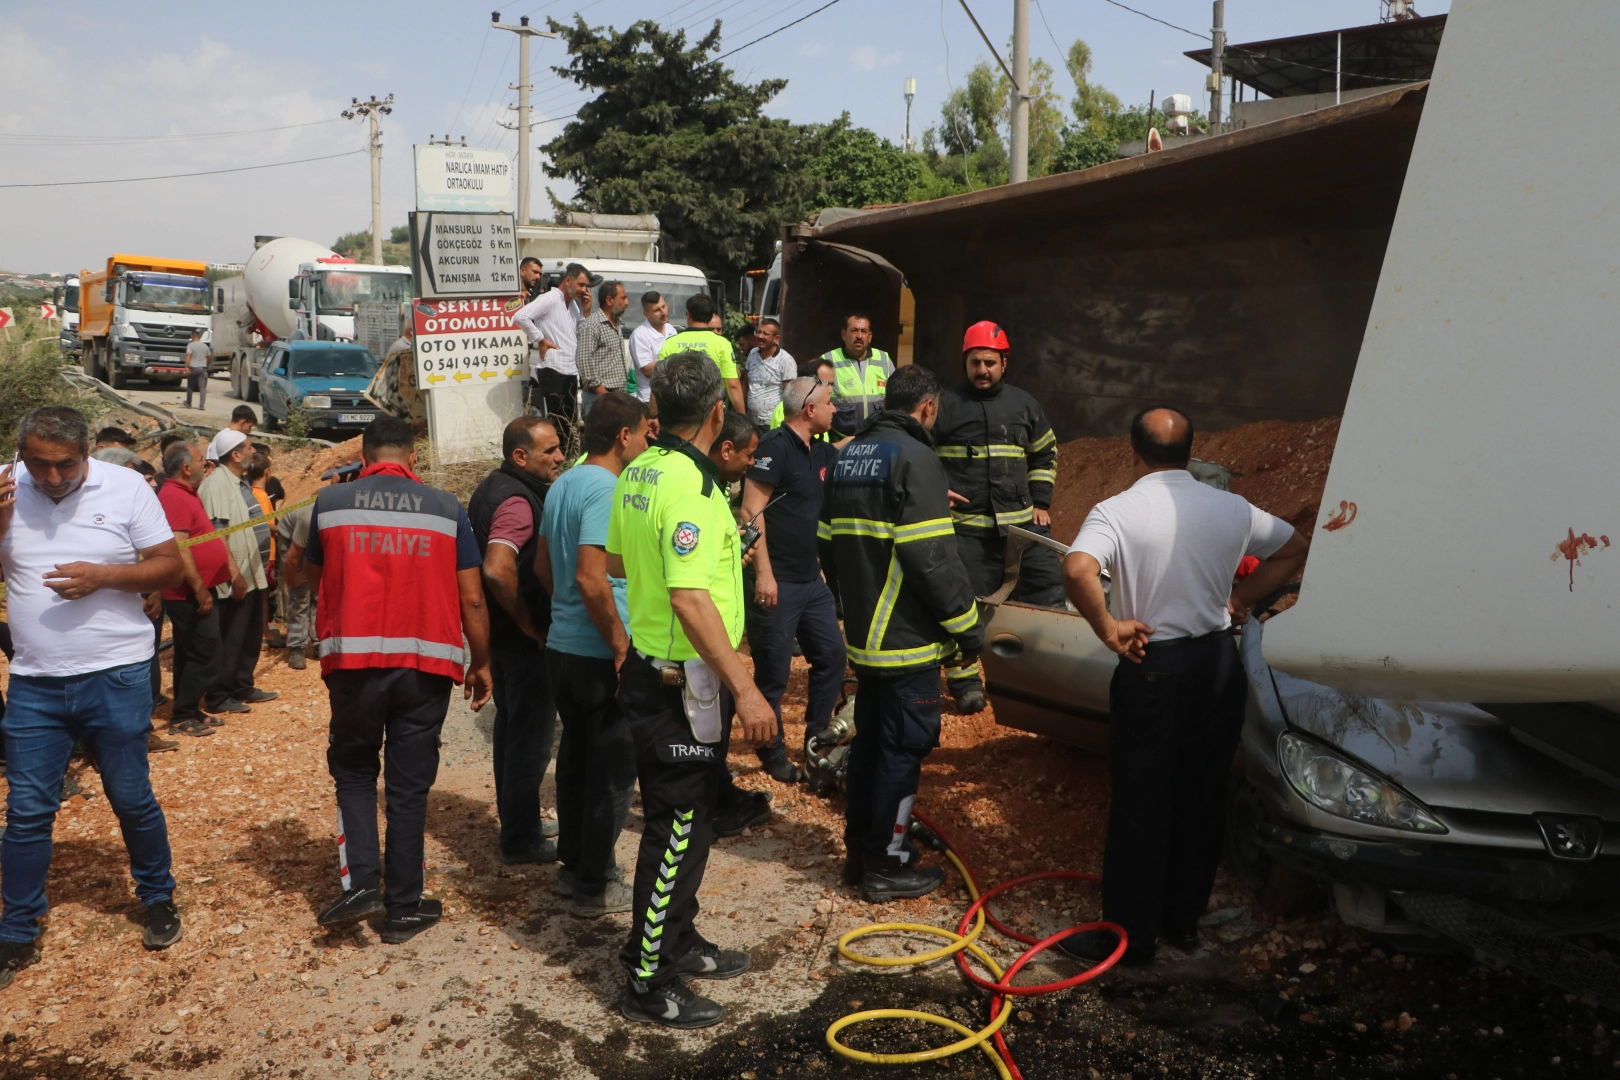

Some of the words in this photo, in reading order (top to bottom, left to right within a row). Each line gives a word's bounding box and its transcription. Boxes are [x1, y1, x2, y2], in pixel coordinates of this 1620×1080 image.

[446, 161, 472, 174] NARLICA
[446, 177, 484, 190] ORTAOKULU
[435, 224, 483, 234] MANSURLU
[491, 224, 496, 234] 5
[496, 225, 511, 234] Km
[437, 238, 483, 251] GÖKÇEGÖZ
[490, 239, 496, 249] 6
[498, 239, 512, 249] Km
[438, 255, 480, 265] AKCURUN
[492, 255, 497, 264] 7
[499, 255, 514, 264] Km
[439, 273, 481, 284] TANIŞMA
[490, 272, 499, 282] 12
[500, 272, 515, 282] Km
[438, 299, 502, 314] SERTEL
[425, 311, 516, 332] OTOMOTİV
[420, 339, 456, 353] OTO
[461, 335, 524, 350] YIKAMA
[438, 357, 459, 371] 541
[463, 355, 489, 369] 949
[493, 354, 509, 367] 30
[513, 353, 524, 365] 31
[847, 443, 879, 456] HATAY
[354, 489, 424, 512] HATAY
[349, 527, 432, 557] İTFAİYE
